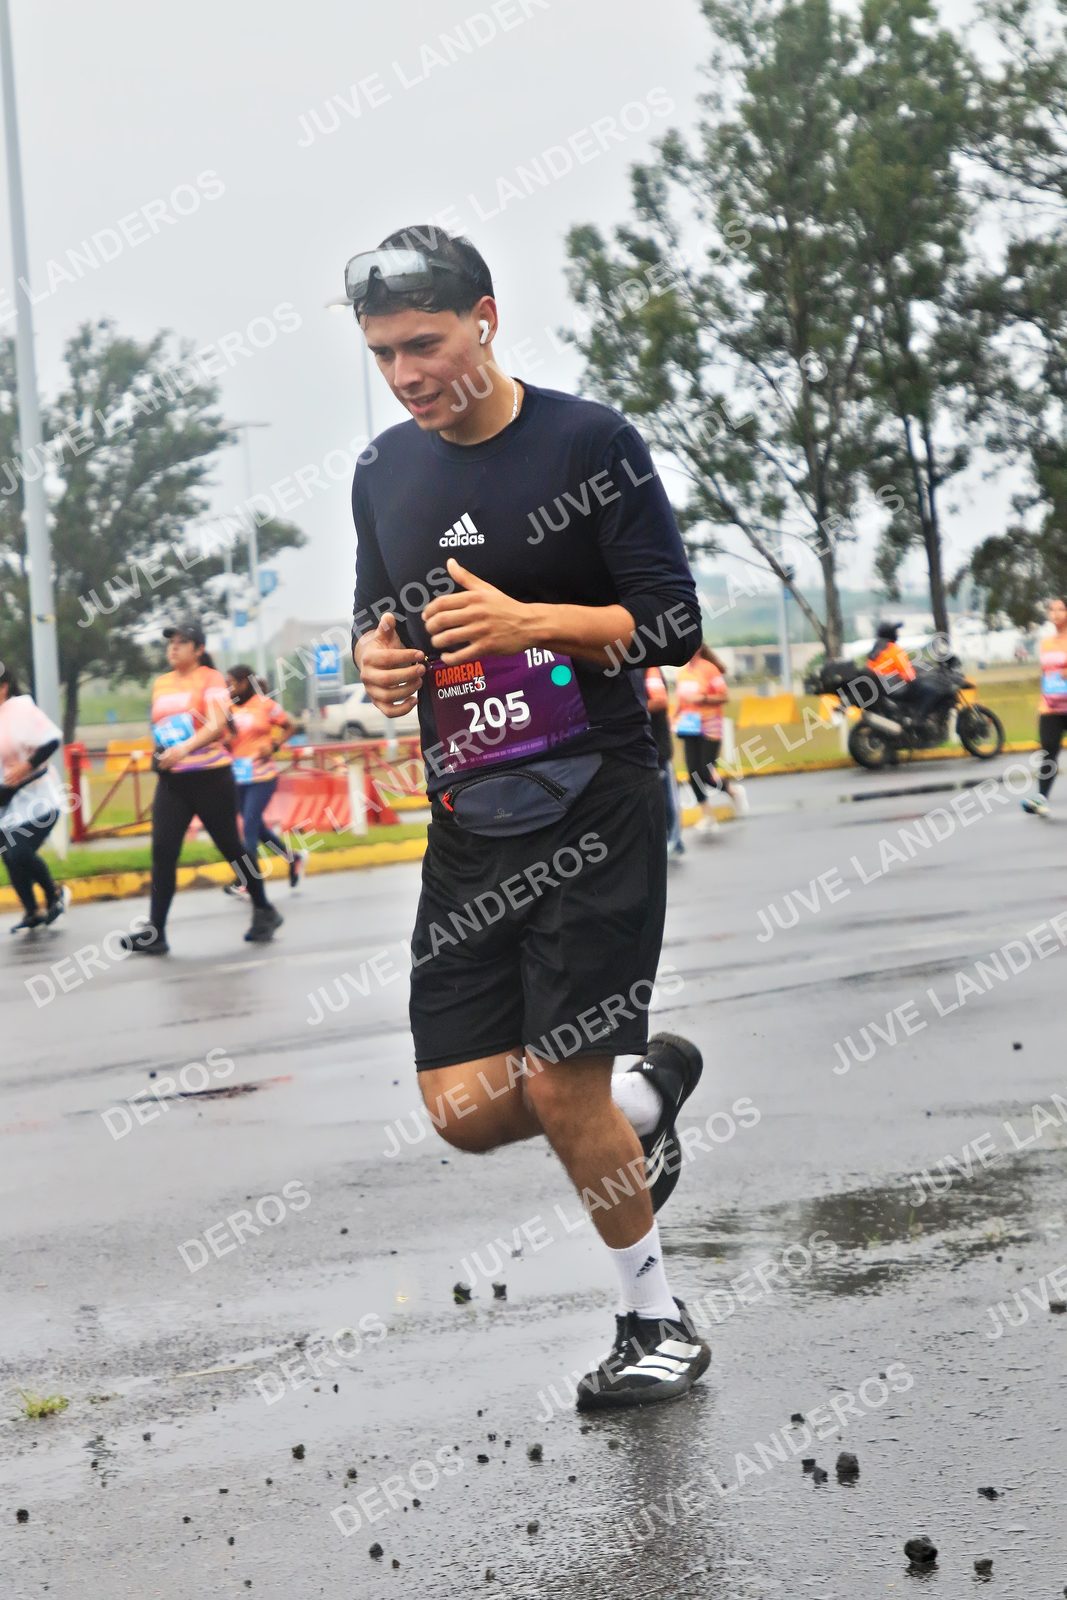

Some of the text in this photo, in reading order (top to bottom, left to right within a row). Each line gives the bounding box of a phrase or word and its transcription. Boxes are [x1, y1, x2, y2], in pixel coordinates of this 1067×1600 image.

[439, 533, 485, 547] adidas
[435, 660, 484, 688] CARRERA
[438, 682, 475, 699] OMNILIFE
[463, 690, 530, 733] 205
